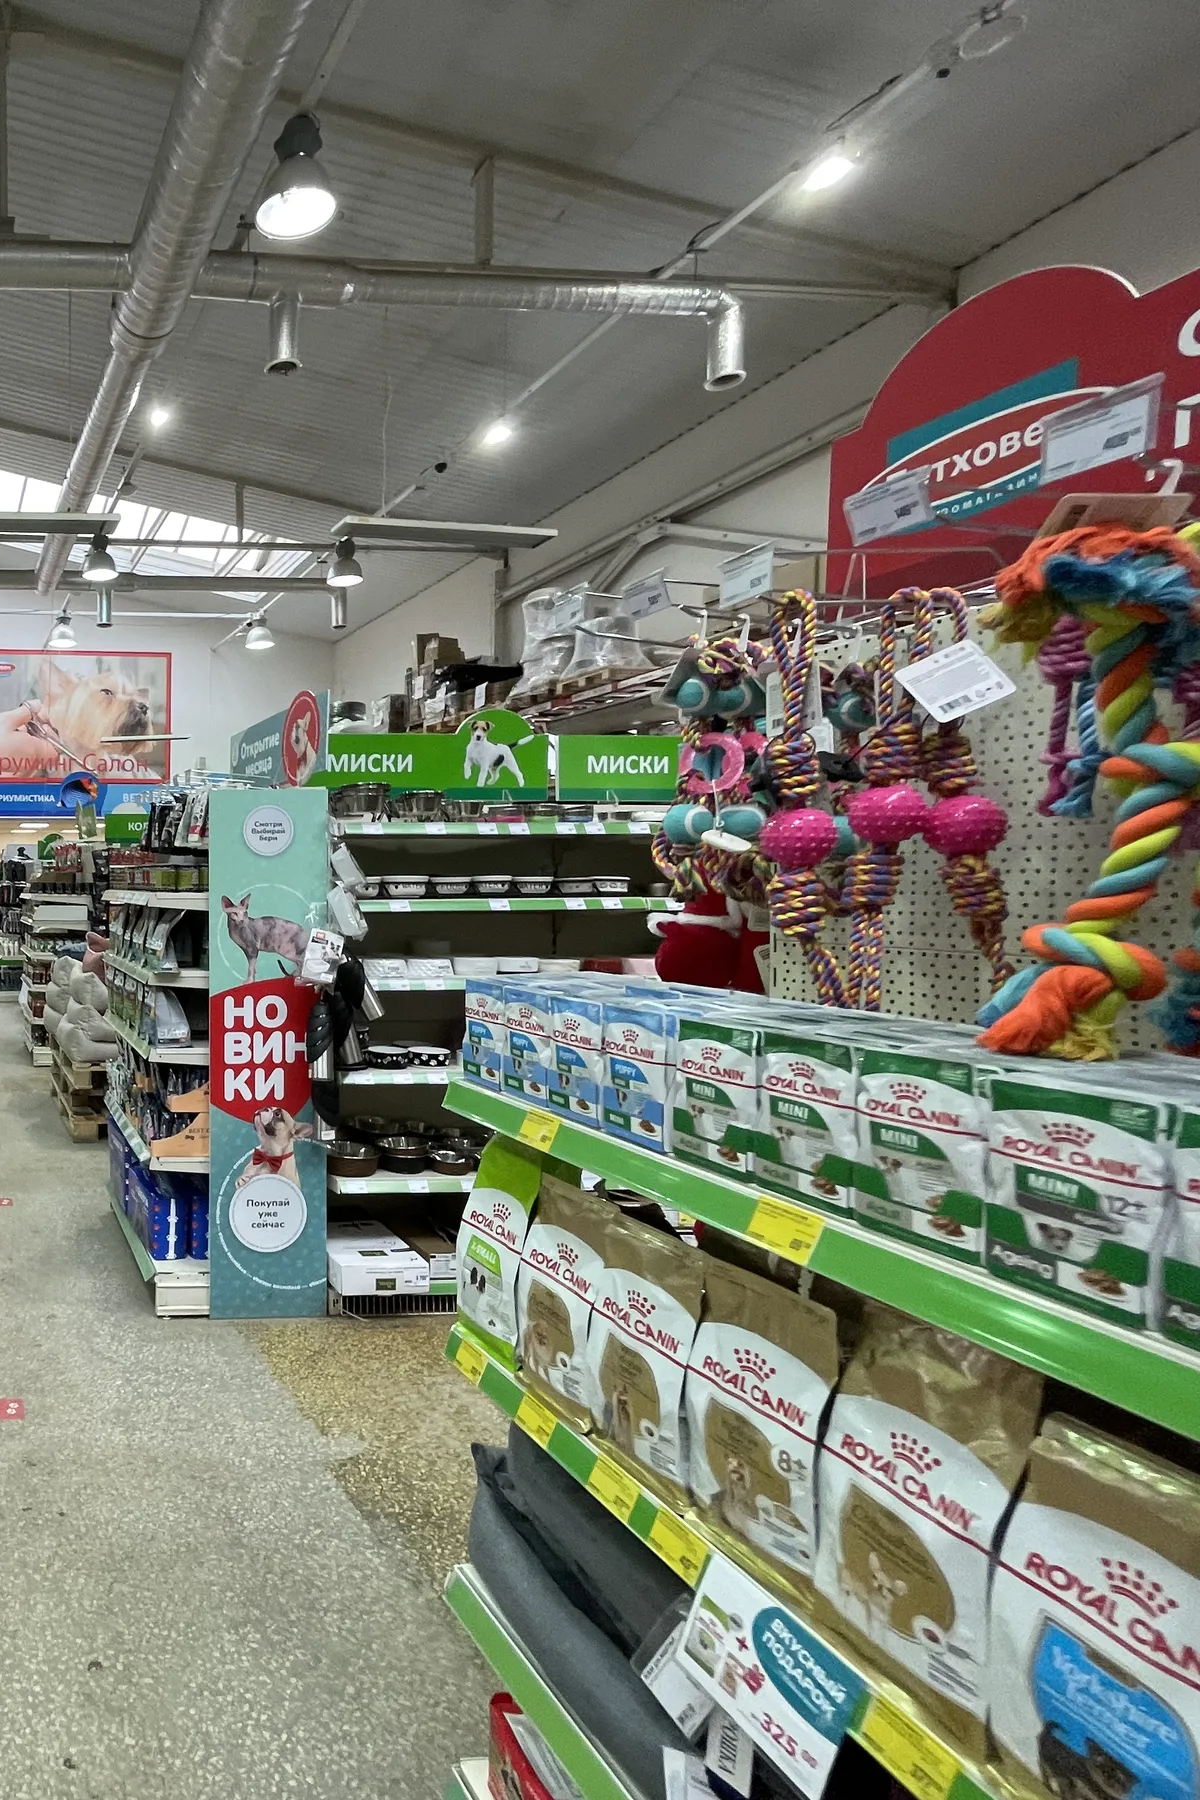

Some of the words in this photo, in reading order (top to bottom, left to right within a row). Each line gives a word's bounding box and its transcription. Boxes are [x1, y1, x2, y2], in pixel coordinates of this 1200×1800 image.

[240, 732, 280, 760] Открытие
[83, 754, 148, 773] Салон
[245, 756, 273, 775] месяца
[326, 754, 413, 773] МИСКИ
[587, 755, 669, 774] МИСКИ
[223, 995, 288, 1029] НО
[605, 1040, 627, 1053] ROYAL
[629, 1045, 655, 1059] CANIN
[614, 1064, 636, 1077] PUPPY
[709, 1065, 744, 1081] CANIN
[223, 1067, 285, 1101] КИ
[692, 1082, 715, 1098] MINI
[777, 1102, 808, 1119] MINI
[865, 1099, 904, 1117] OYAL
[880, 1128, 918, 1149] MINI
[246, 1198, 290, 1209] Покупай
[251, 1220, 285, 1229] сейчас
[258, 1211, 278, 1219] уже
[470, 1210, 495, 1232] ROYAL
[529, 1248, 560, 1276] ROYAL
[562, 1268, 591, 1295] CANIN
[603, 1296, 631, 1330] ROYAL
[634, 1318, 680, 1354] CANIN
[702, 1355, 748, 1394] ROYAL
[751, 1385, 806, 1427] CANIN
[841, 1433, 898, 1484] ROYAL
[901, 1474, 973, 1533] CANIN
[1024, 1551, 1119, 1627] ROYAL
[762, 1630, 836, 1722] ПОДАРОК
[760, 1711, 798, 1757] 325
